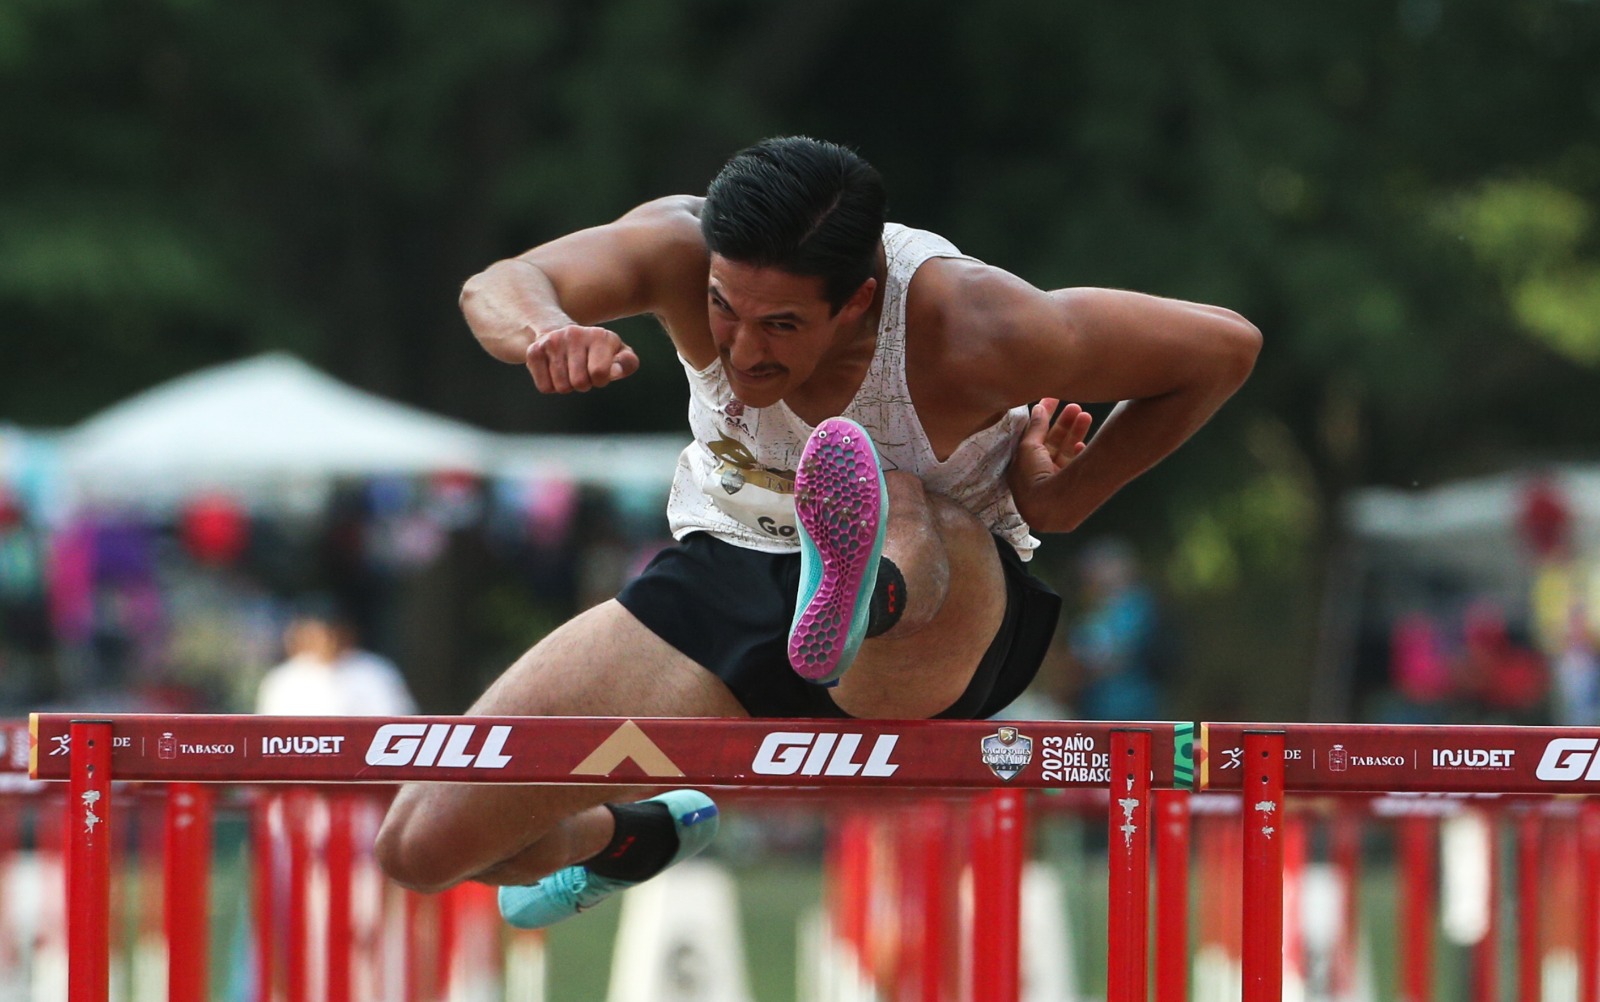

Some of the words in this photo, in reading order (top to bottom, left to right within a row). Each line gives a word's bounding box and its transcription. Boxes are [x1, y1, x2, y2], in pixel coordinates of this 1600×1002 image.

[180, 744, 235, 754] TABASCO
[365, 723, 513, 769] GILL
[1064, 732, 1095, 752] AÑO
[751, 731, 900, 777] GILL
[1042, 736, 1063, 781] 2023
[1063, 752, 1088, 767] DEL
[1350, 756, 1405, 766] TABASCO
